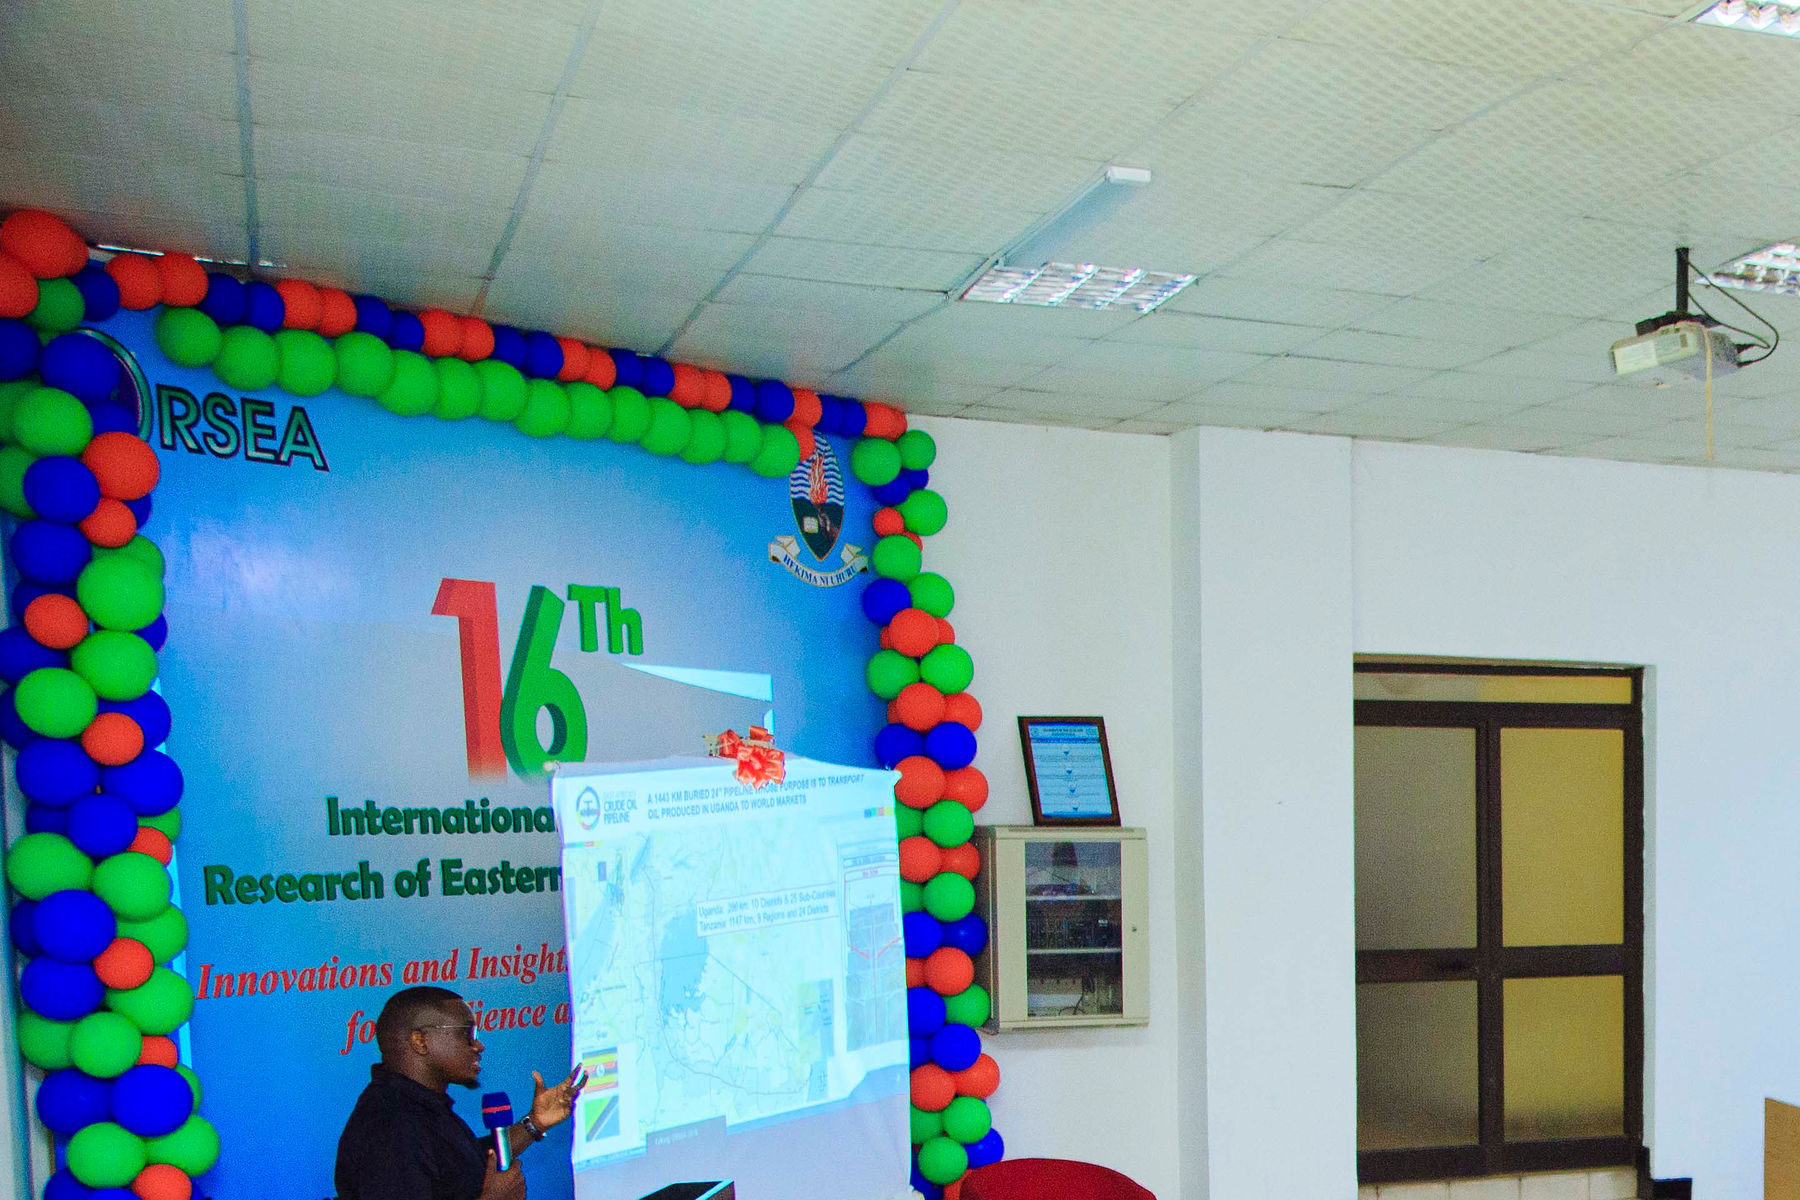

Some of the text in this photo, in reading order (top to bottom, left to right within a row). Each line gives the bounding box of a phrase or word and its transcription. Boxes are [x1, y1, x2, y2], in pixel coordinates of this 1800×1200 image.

[671, 791, 682, 803] KM
[684, 788, 710, 802] BURIED
[828, 774, 865, 786] TRANSPORT
[326, 796, 558, 836] Internationa
[604, 800, 625, 812] CRUDE
[604, 811, 630, 824] PIPELINE
[648, 809, 660, 820] OIL
[661, 805, 700, 819] PRODUCED
[710, 800, 739, 813] UGANDA
[741, 800, 749, 811] TO
[751, 798, 775, 809] WORLD
[776, 794, 807, 806] MARKETS
[203, 859, 384, 906] Research
[394, 858, 432, 898] of
[195, 942, 568, 1001] Innovations and Insight
[340, 1009, 376, 1055] fo
